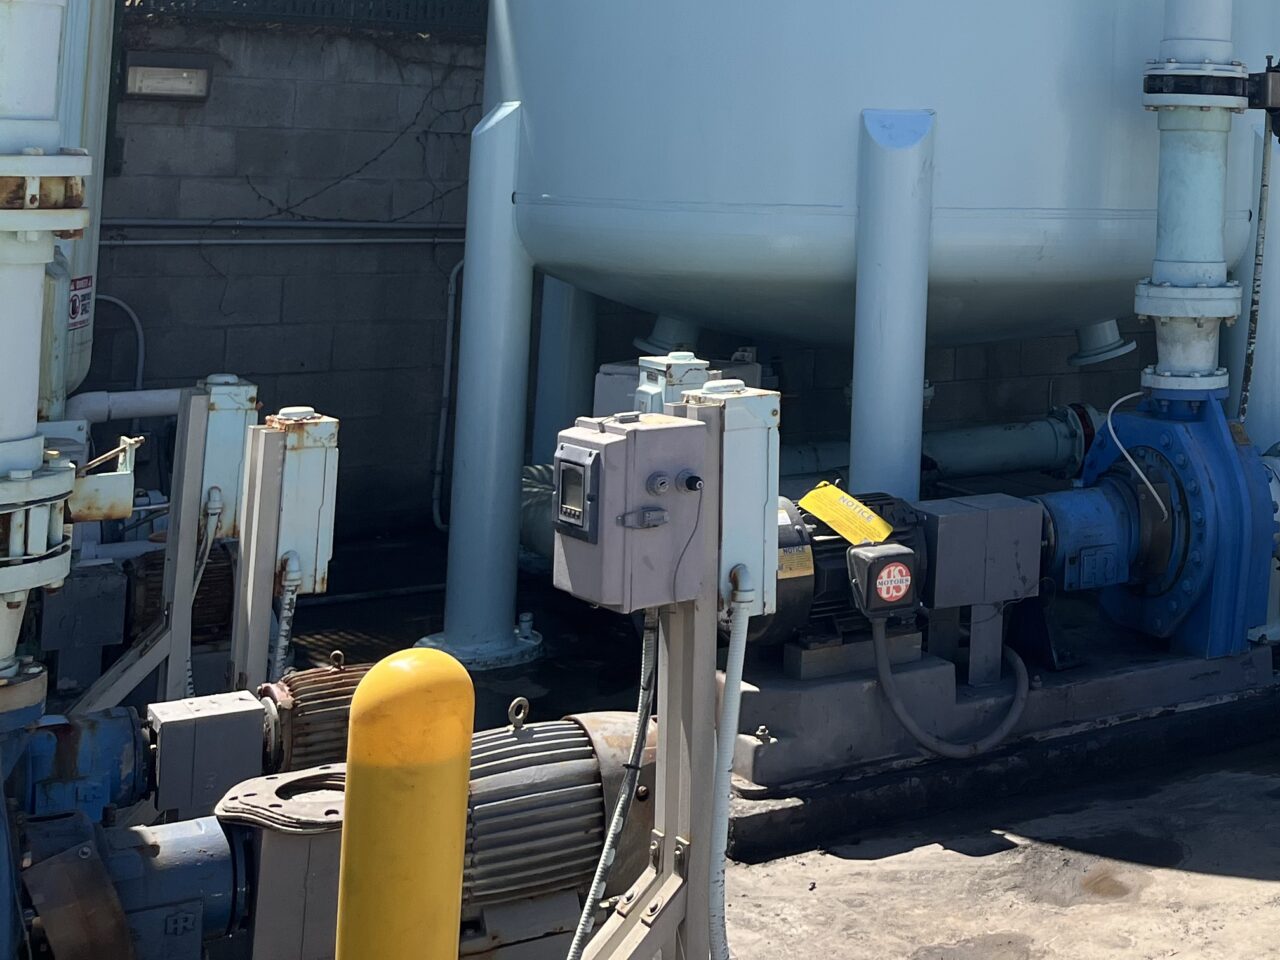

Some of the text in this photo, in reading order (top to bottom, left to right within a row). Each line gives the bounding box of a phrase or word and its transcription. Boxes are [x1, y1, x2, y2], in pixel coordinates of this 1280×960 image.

[840, 495, 875, 522] NOTICE
[877, 577, 910, 587] MOTORS
[880, 565, 908, 599] US
